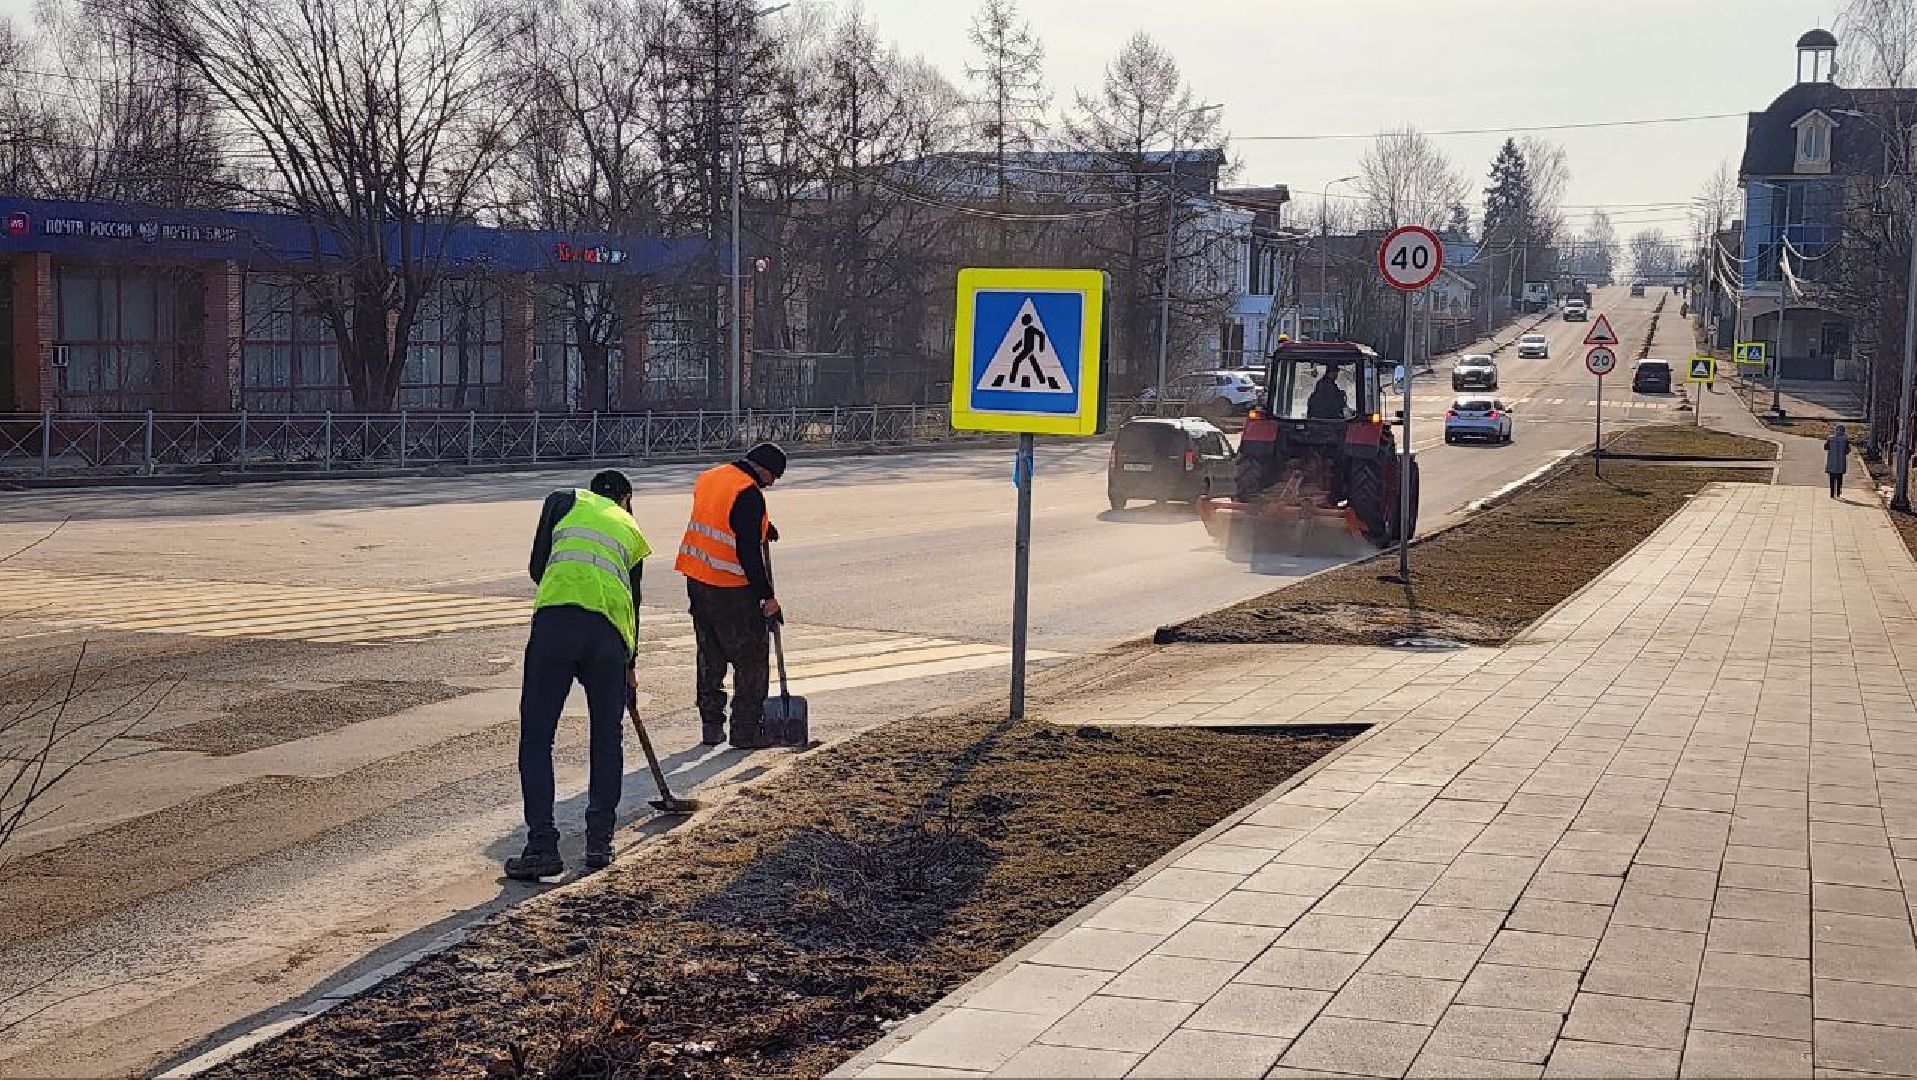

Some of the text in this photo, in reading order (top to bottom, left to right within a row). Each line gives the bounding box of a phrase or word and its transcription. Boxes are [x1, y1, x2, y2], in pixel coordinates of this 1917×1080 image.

[46, 219, 132, 237] ПОЧТА РОССИИ
[162, 225, 200, 240] ПОЧТА
[1391, 245, 1429, 270] 40
[1592, 355, 1610, 367] 20
